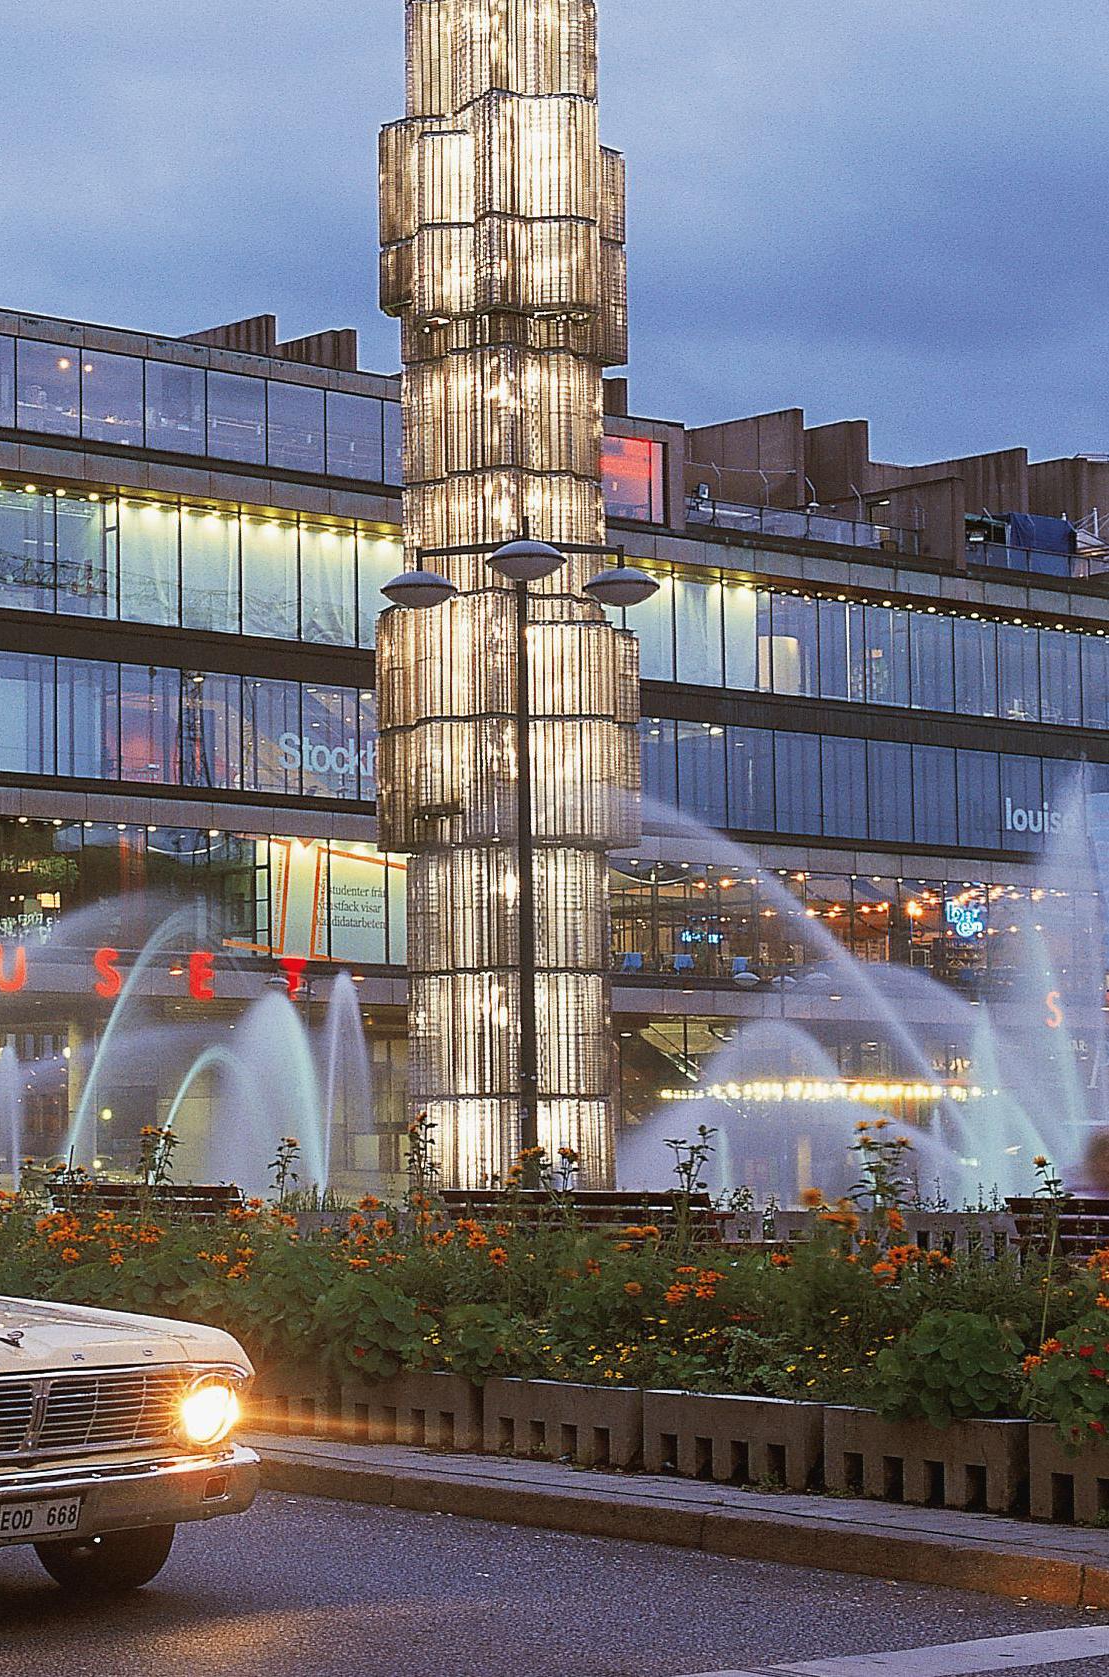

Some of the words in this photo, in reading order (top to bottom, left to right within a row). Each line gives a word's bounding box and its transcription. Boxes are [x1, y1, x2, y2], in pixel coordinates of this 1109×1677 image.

[330, 885, 369, 898] tudenter
[318, 900, 359, 912] stfack
[361, 902, 382, 913] visar
[317, 915, 385, 930] didatarbeten
[0, 1509, 32, 1531] EOD
[47, 1504, 77, 1526] 668
